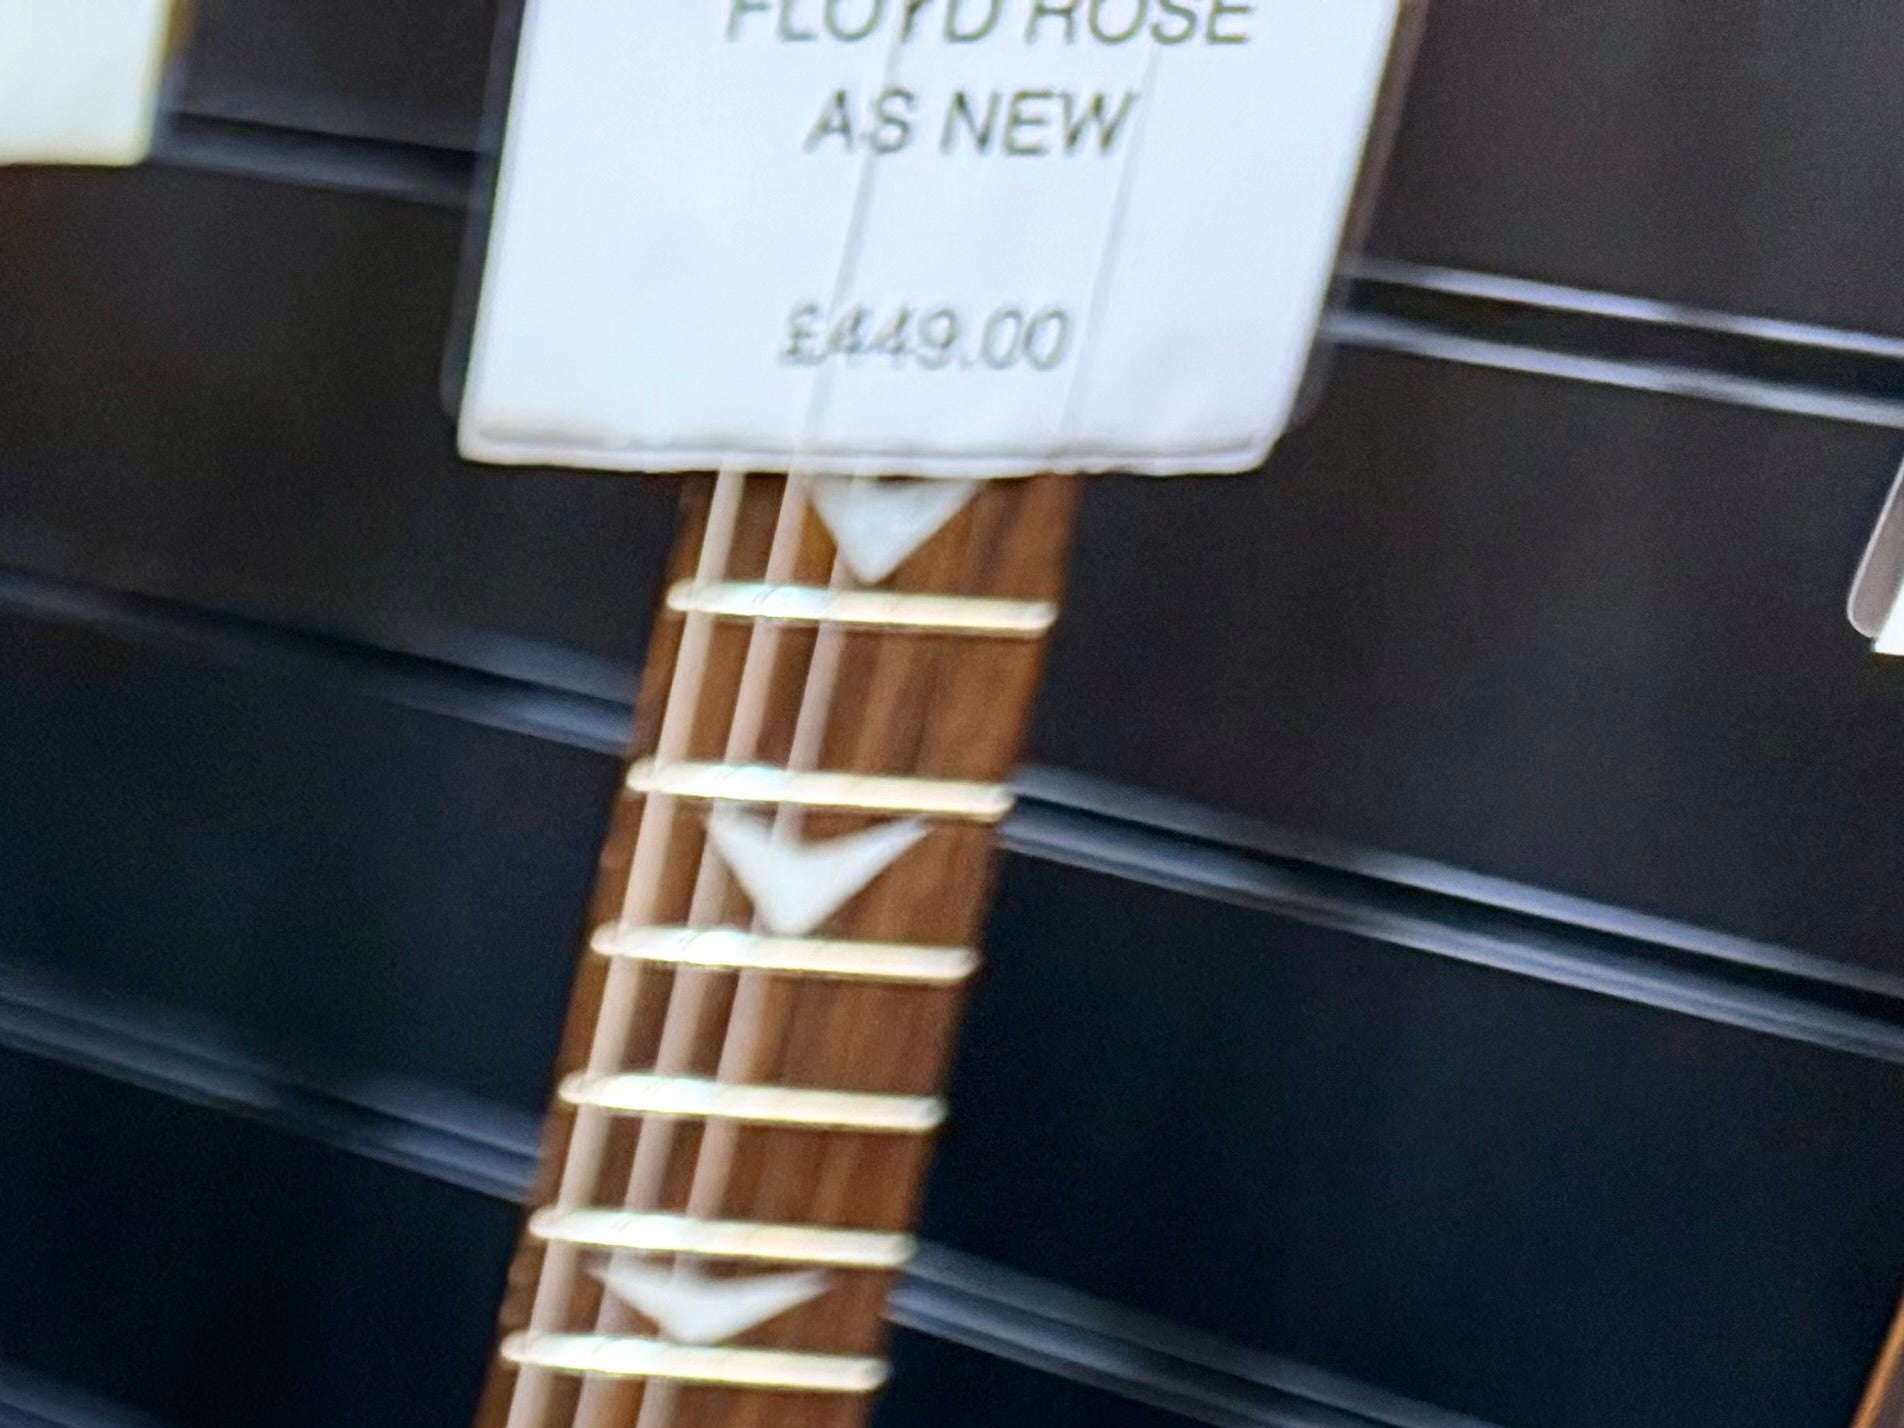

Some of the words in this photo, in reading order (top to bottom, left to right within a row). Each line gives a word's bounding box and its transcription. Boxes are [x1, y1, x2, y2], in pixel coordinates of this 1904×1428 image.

[727, 0, 998, 42] FLOYD
[1025, 0, 1253, 45] ROSE
[804, 88, 913, 155] AS
[941, 88, 1139, 155] NEW
[781, 304, 1070, 371] £449.00
